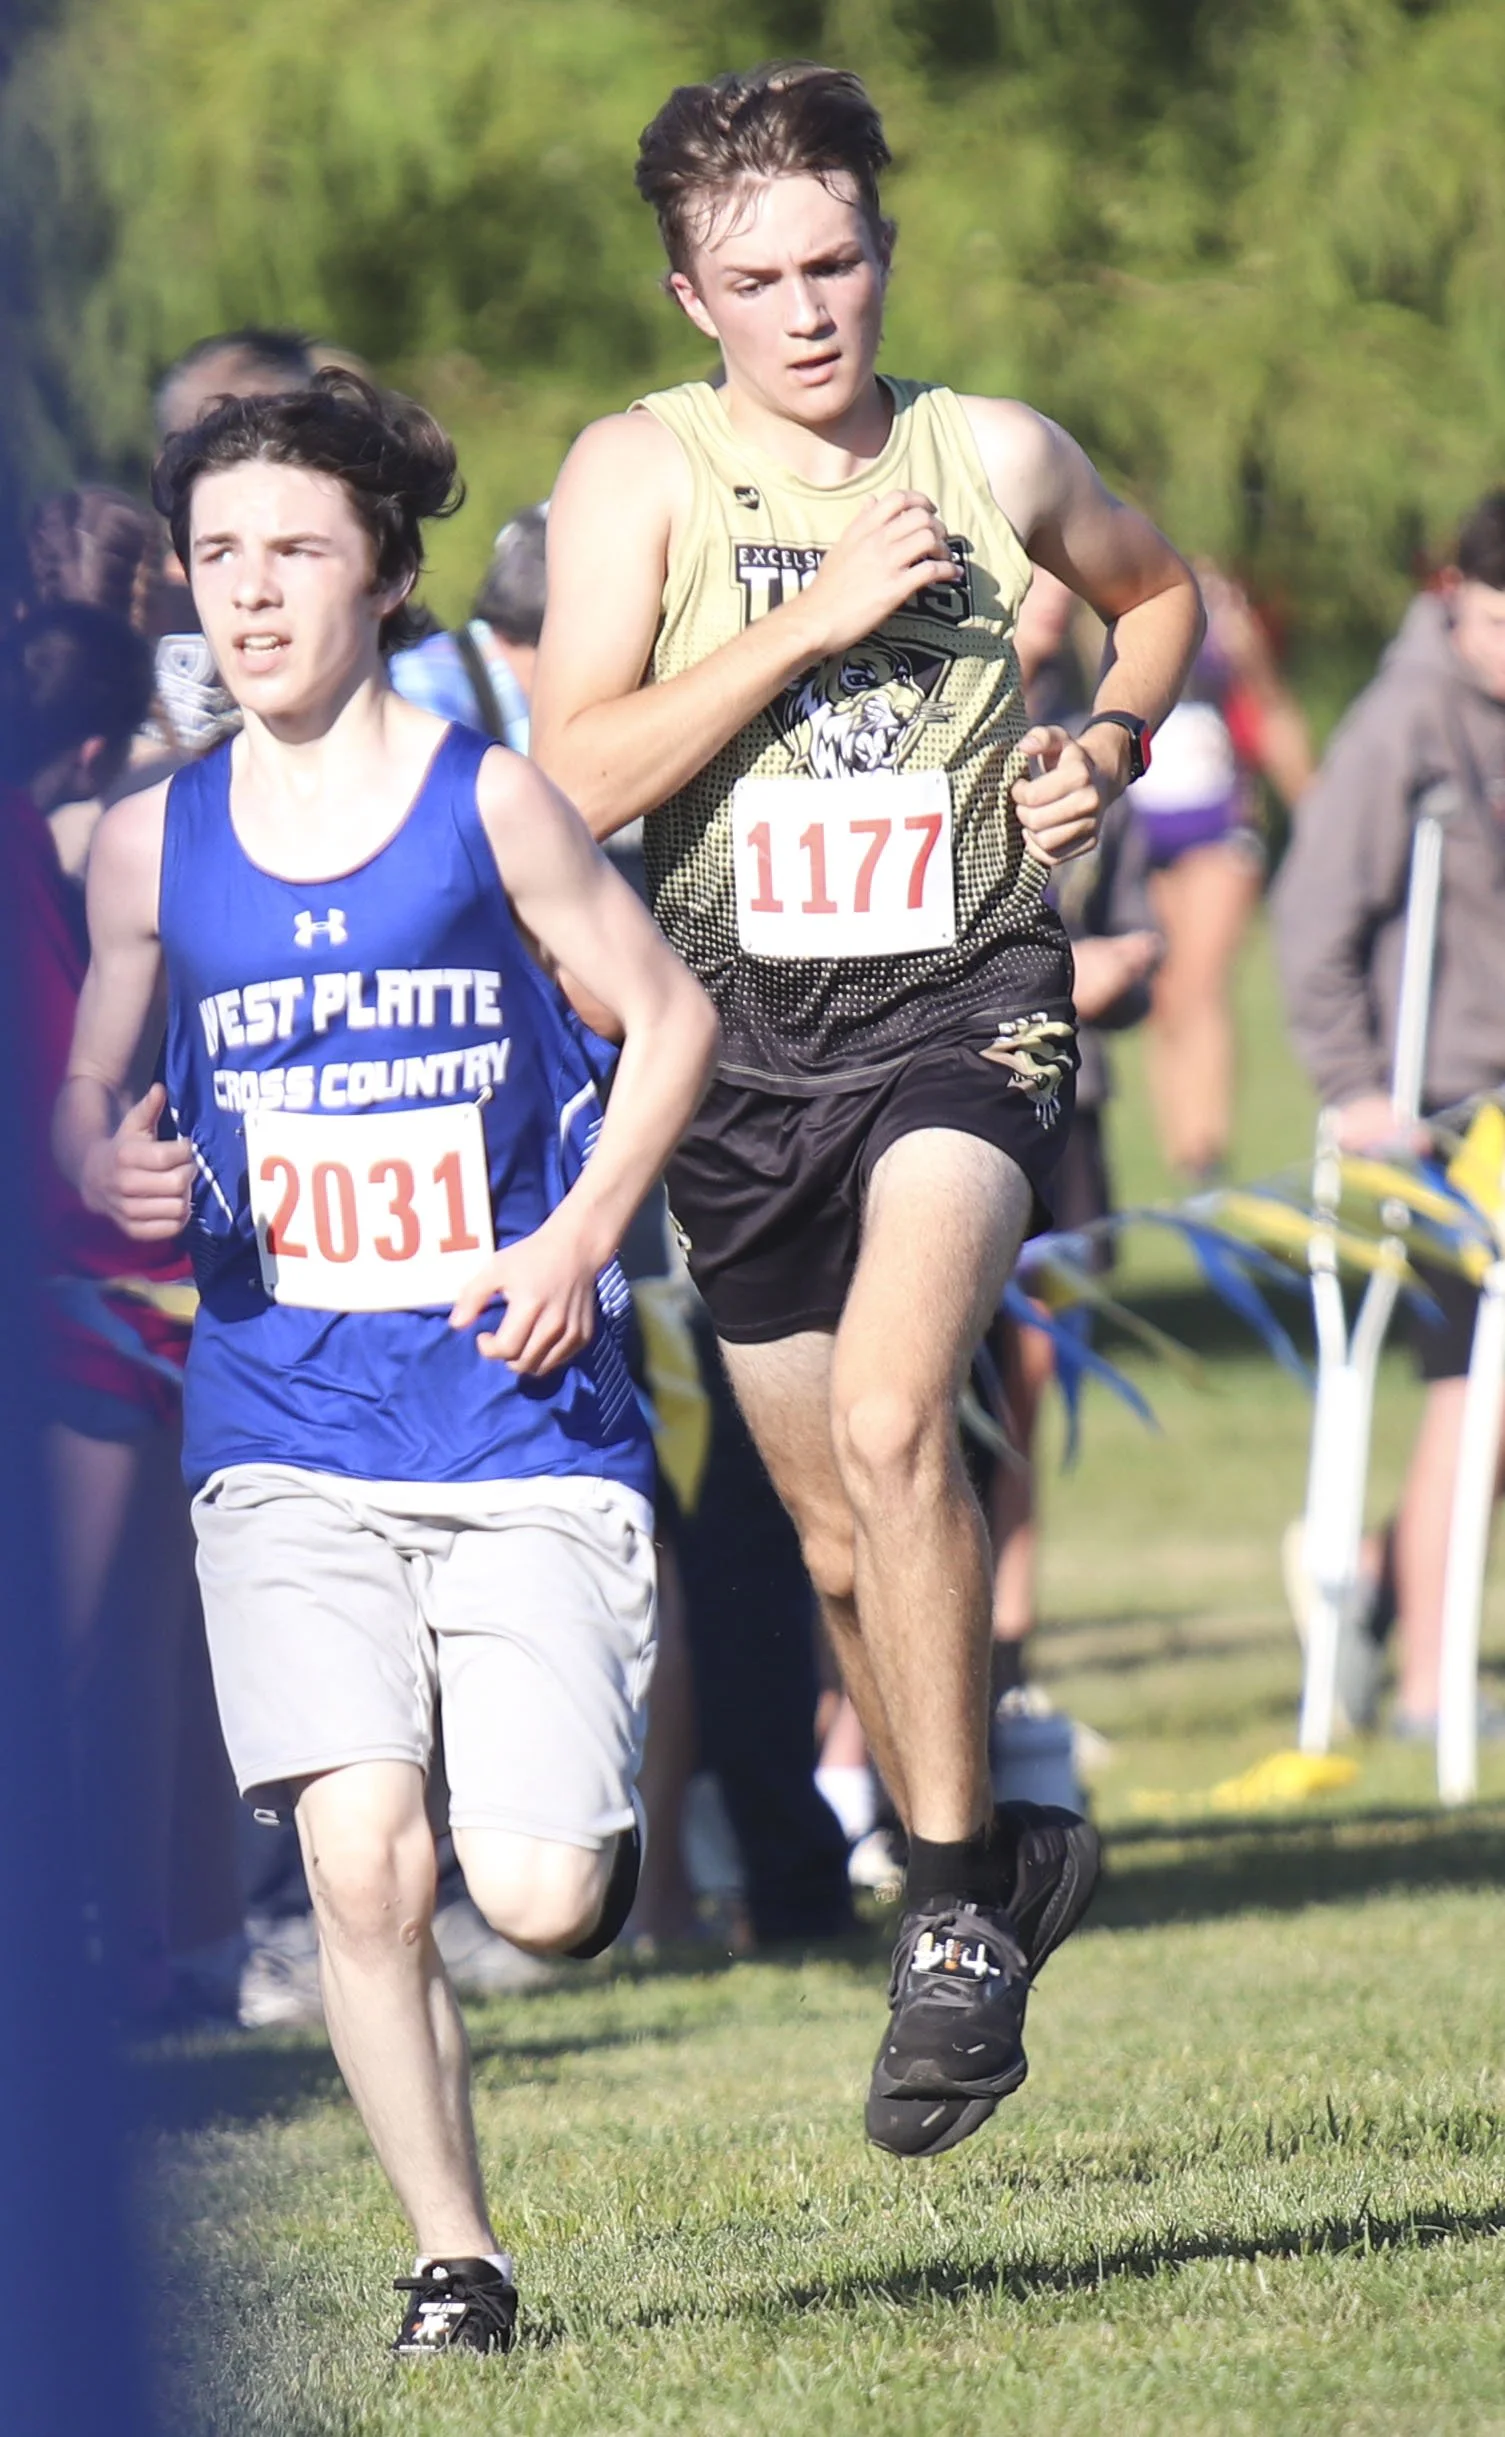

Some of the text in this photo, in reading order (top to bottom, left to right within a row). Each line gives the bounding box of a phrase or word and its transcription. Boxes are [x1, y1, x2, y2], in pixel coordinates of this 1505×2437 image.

[738, 548, 822, 567] EXCELSI
[746, 812, 943, 914] 1177
[199, 967, 502, 1058] WEST PLATTE
[213, 1037, 511, 1114] CROSS COUNTRY
[259, 1150, 481, 1264] 2031
